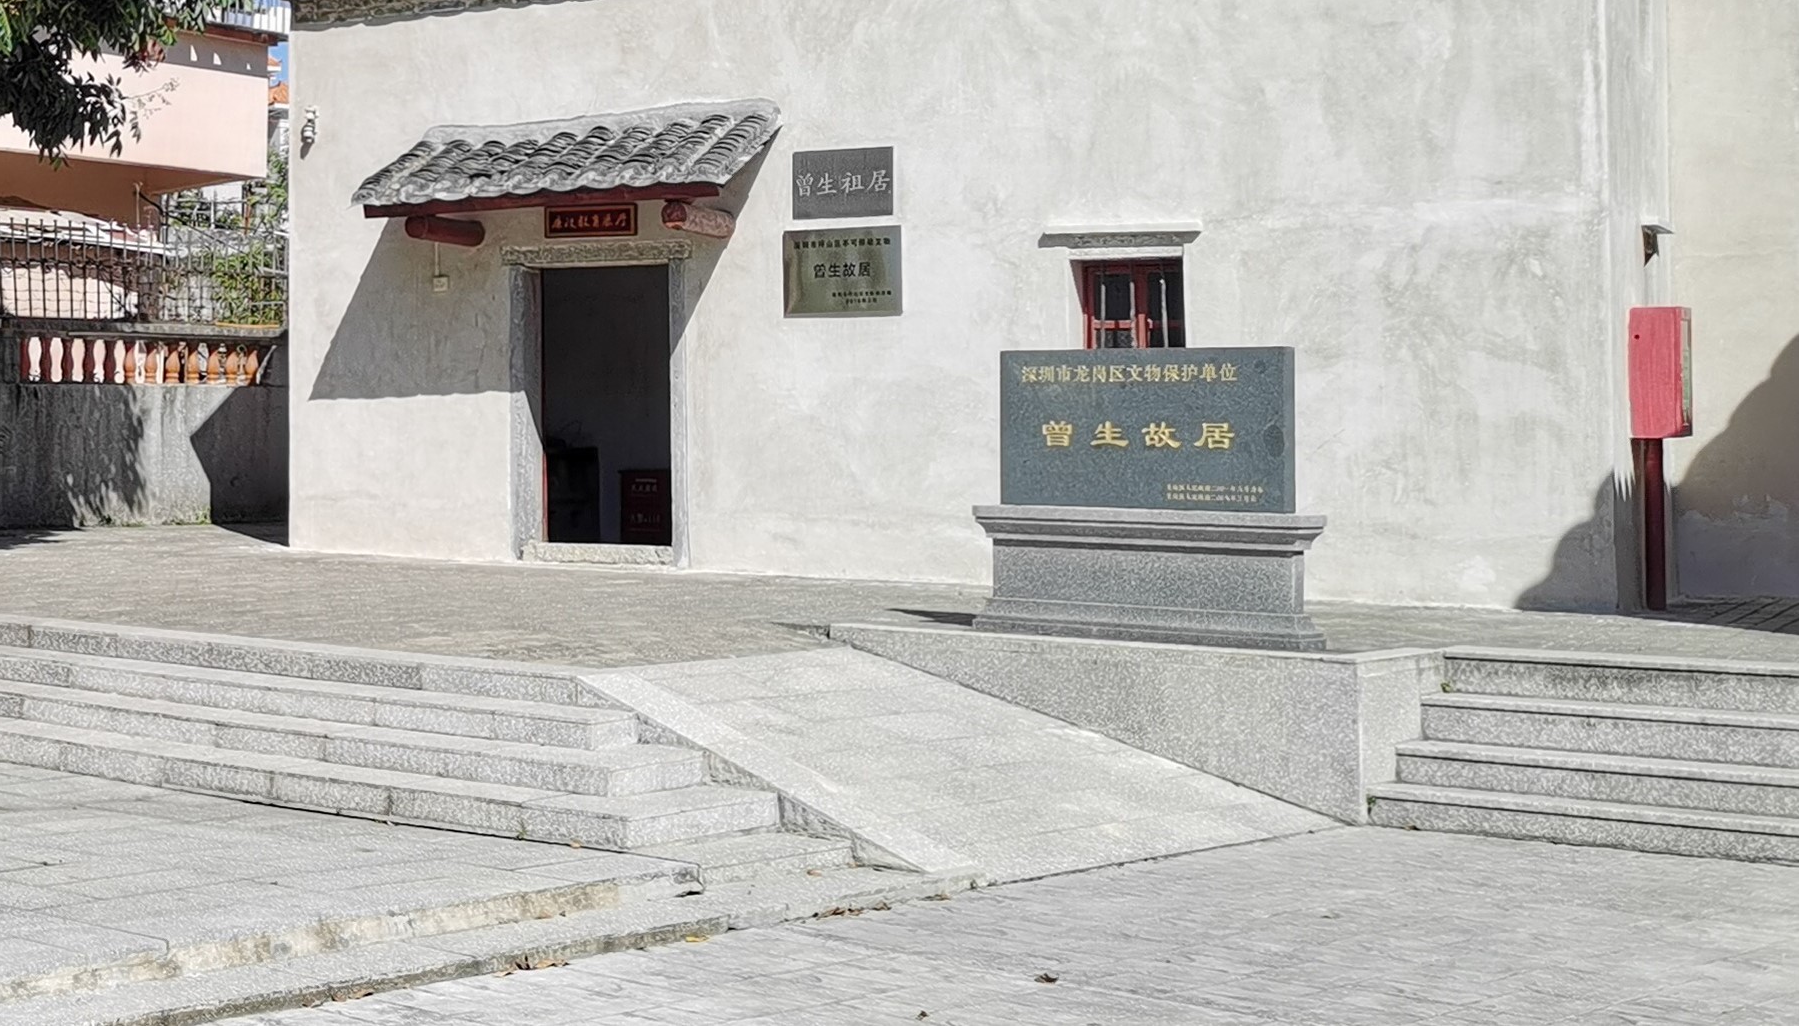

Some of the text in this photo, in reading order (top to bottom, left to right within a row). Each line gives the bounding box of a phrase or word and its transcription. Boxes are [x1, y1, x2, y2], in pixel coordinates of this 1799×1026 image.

[795, 169, 891, 196] 曾生祖居
[813, 262, 871, 278] 曾生故居
[1021, 362, 1238, 383] 深圳市龙岗区文物保护单位
[1042, 420, 1235, 449] 曾生故居
